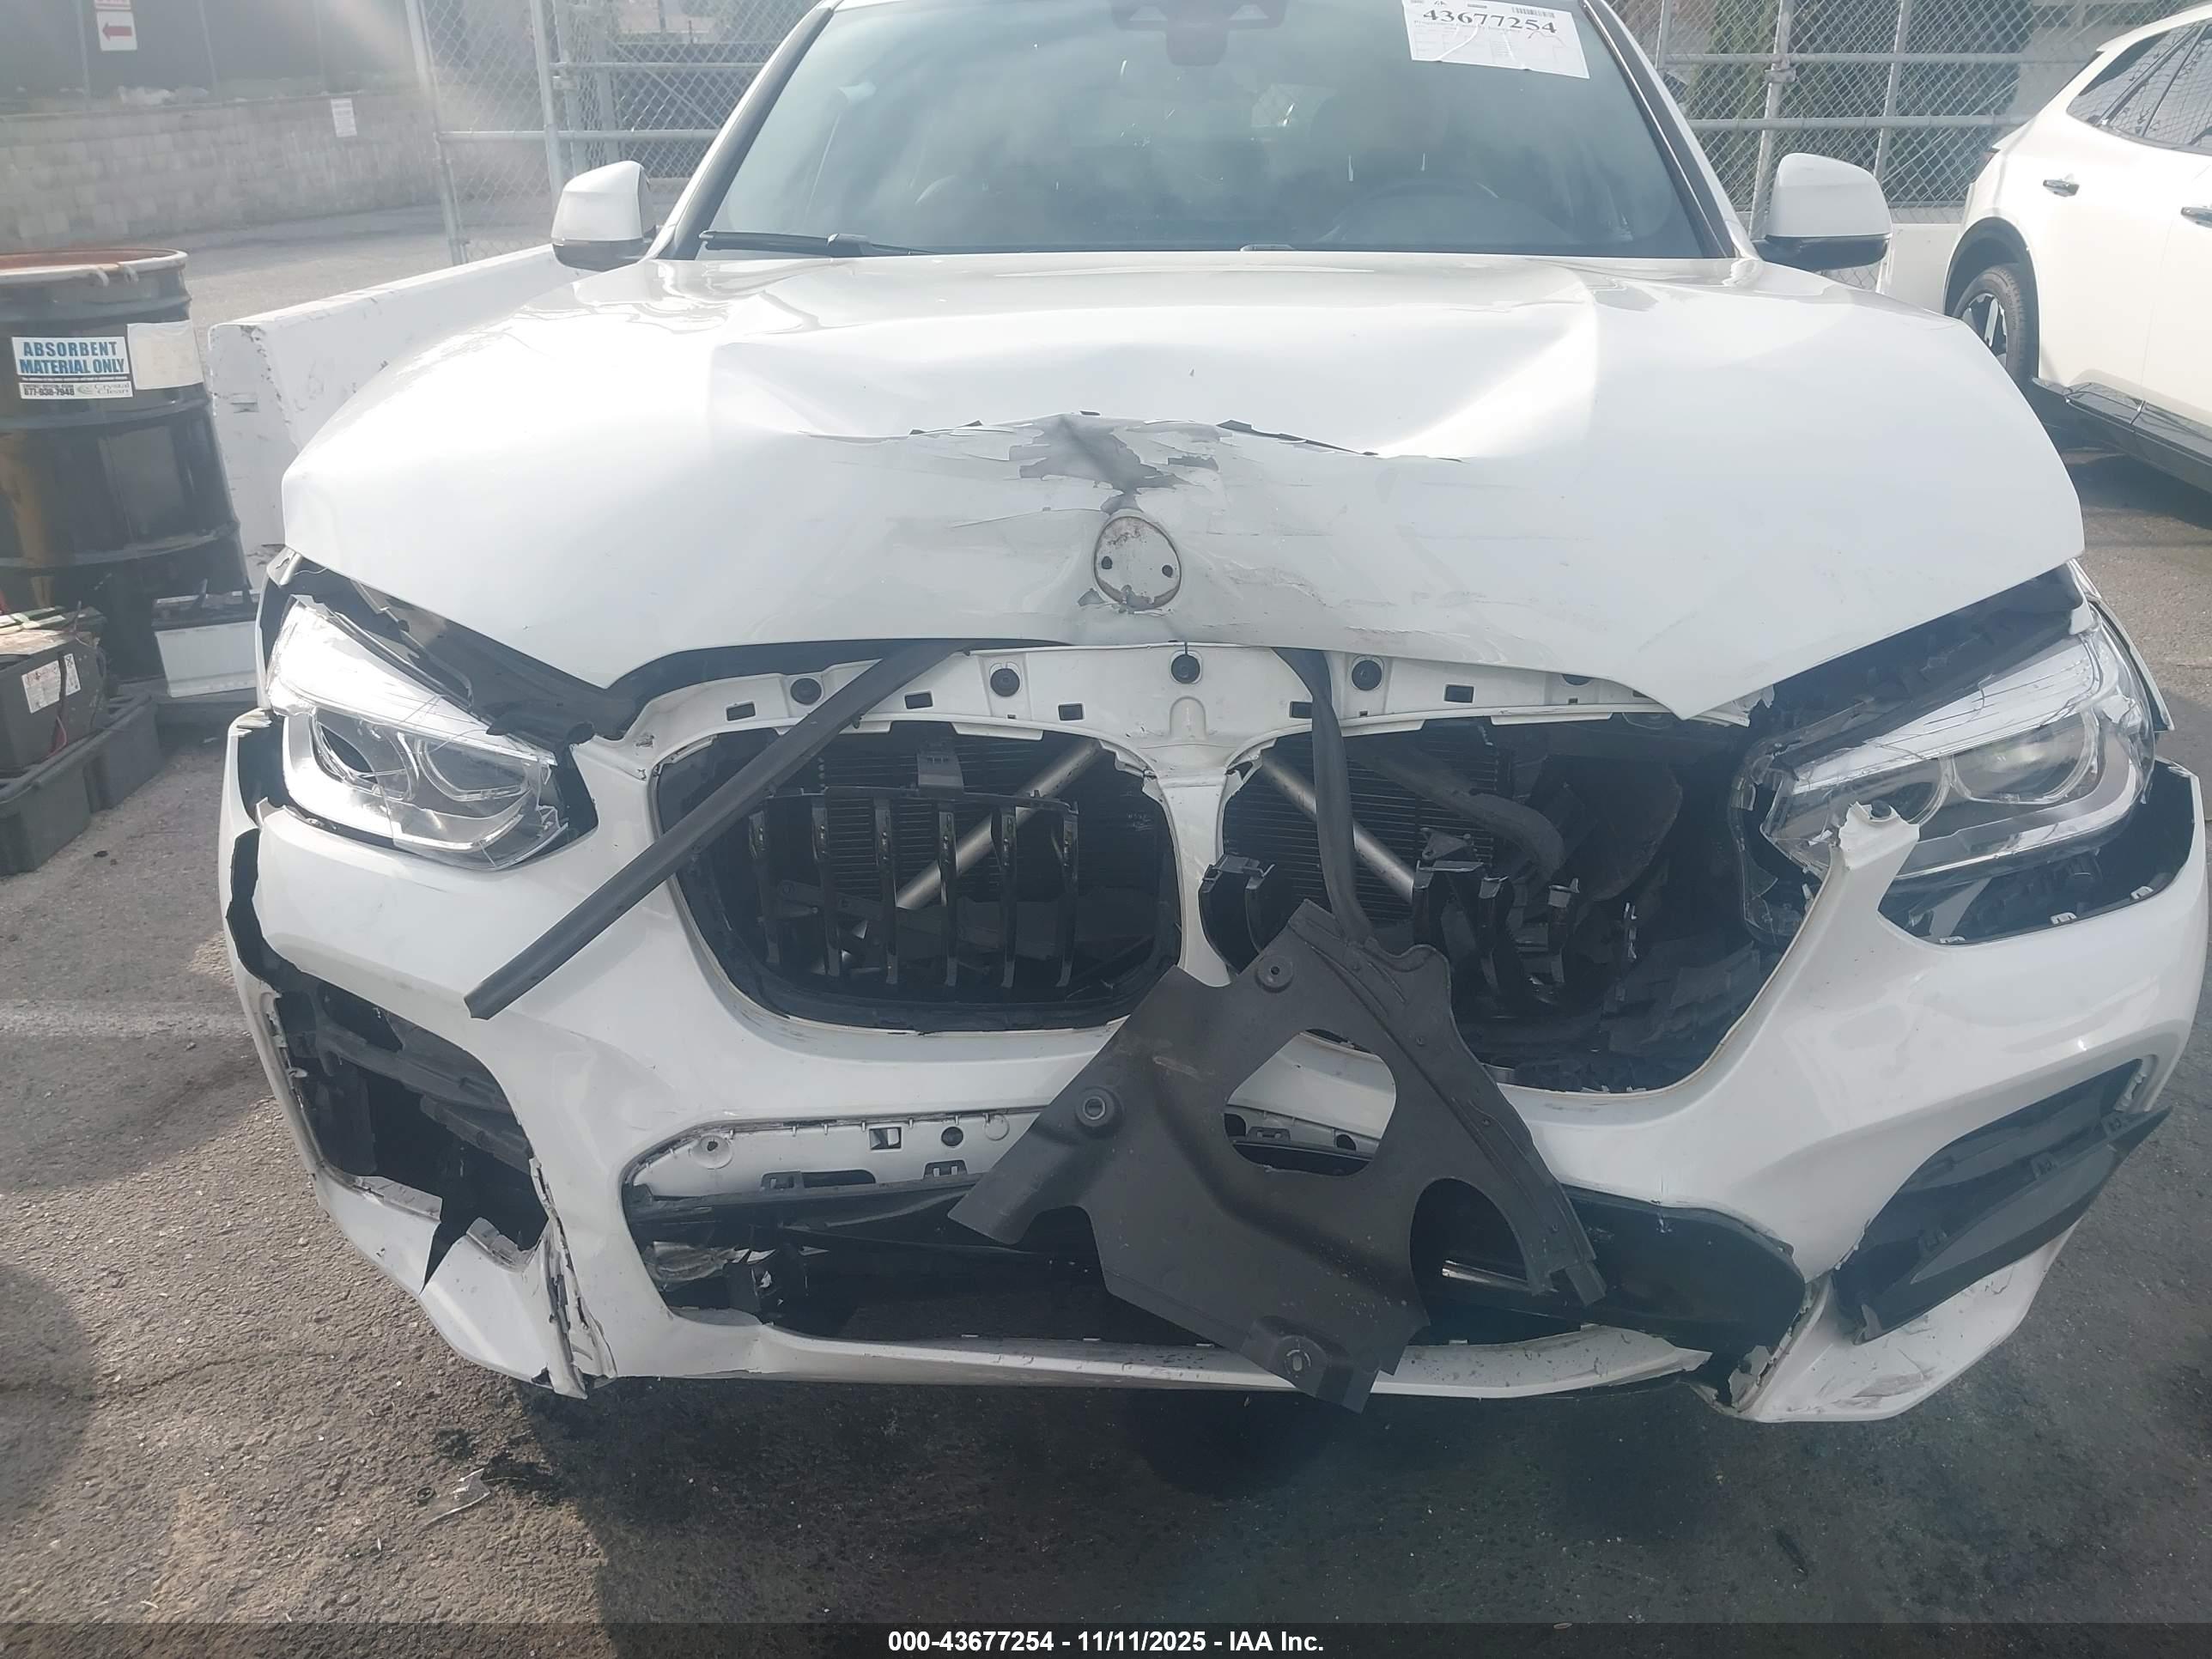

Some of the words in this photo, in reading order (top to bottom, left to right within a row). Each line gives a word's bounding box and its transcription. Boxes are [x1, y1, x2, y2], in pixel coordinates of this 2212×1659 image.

[1423, 9, 1557, 33] 43677254
[23, 342, 118, 356] ABSORBENT
[19, 359, 90, 374] MATERIAL
[93, 359, 125, 374] ONLY
[94, 382, 130, 391] Crystal
